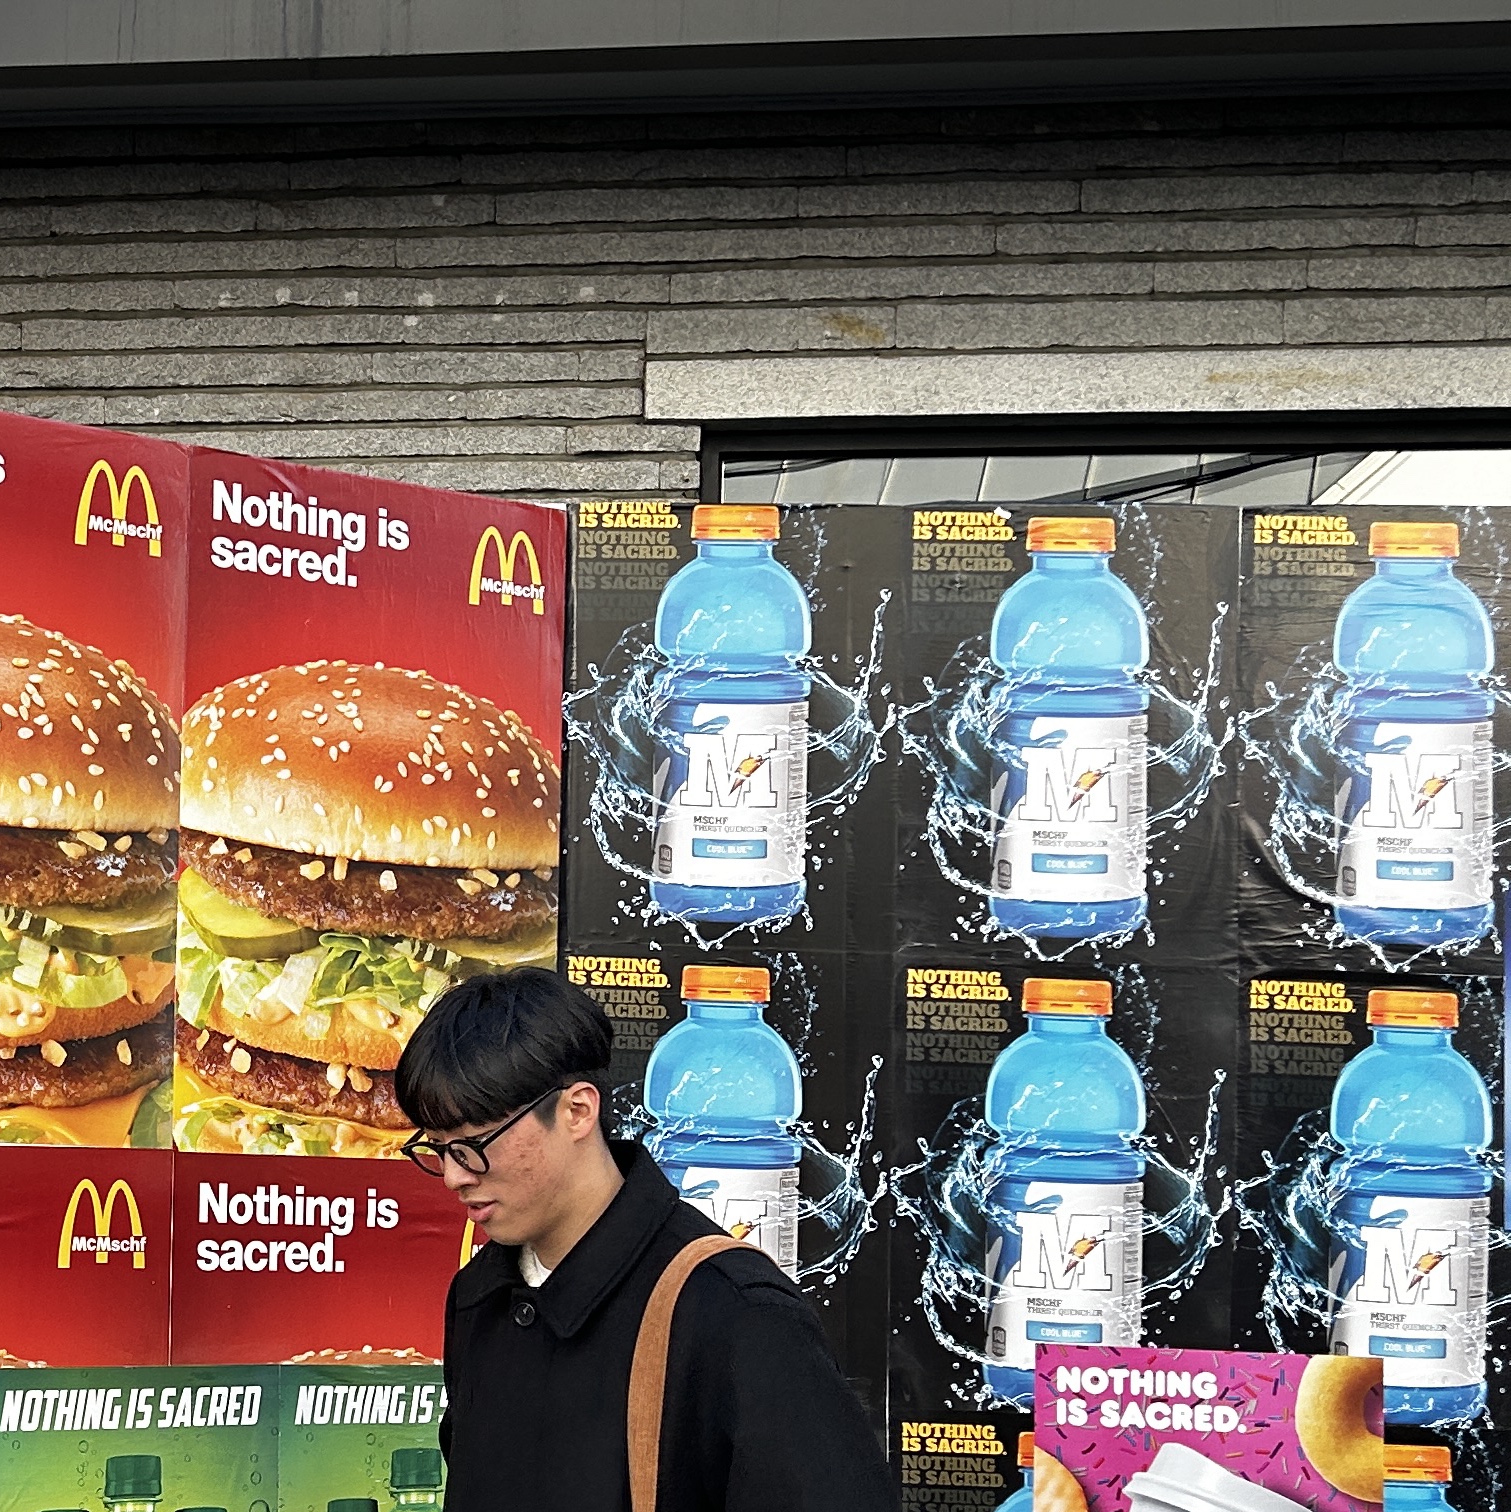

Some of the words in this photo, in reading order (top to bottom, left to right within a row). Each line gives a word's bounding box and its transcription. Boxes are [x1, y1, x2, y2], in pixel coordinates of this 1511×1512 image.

[211, 481, 367, 551] Nothing
[377, 510, 410, 551] is
[579, 502, 671, 514] NOTHING
[579, 514, 596, 528] IS
[601, 513, 682, 529] SACRED.
[913, 511, 1006, 526] NOTHING
[1254, 514, 1348, 530] NOTHING
[88, 515, 162, 542] McMschf
[913, 526, 929, 540] IS
[934, 526, 1017, 541] SACRED.
[1254, 529, 1273, 544] IS
[1278, 530, 1359, 546] SACRED.
[210, 534, 357, 588] sacred.
[480, 578, 545, 600] McMschf
[568, 956, 661, 973] NOTHING
[568, 971, 586, 985] IS
[590, 971, 671, 989] SACRED.
[907, 968, 1001, 986] NOTHING
[907, 984, 926, 998] IS
[931, 985, 1013, 1001] SACRED.
[1250, 980, 1346, 997] NOTHING
[1250, 994, 1269, 1009] IS
[1273, 996, 1357, 1013] SACRED.
[197, 1183, 355, 1234] Nothing
[365, 1192, 399, 1230] is
[72, 1236, 146, 1253] McMschf
[197, 1234, 345, 1273] sacred.
[1056, 1365, 1217, 1401] NOTHING
[0, 1389, 123, 1432] NOTHING
[126, 1389, 154, 1428] IS
[158, 1386, 262, 1428] SACRED
[294, 1385, 406, 1424] NOTHING
[408, 1385, 436, 1424] IS
[1056, 1399, 1084, 1427] IS
[1100, 1401, 1247, 1434] SACRED.
[902, 1421, 996, 1439] NOTHING
[902, 1438, 922, 1453] IS
[927, 1438, 1008, 1456] SACRED.
